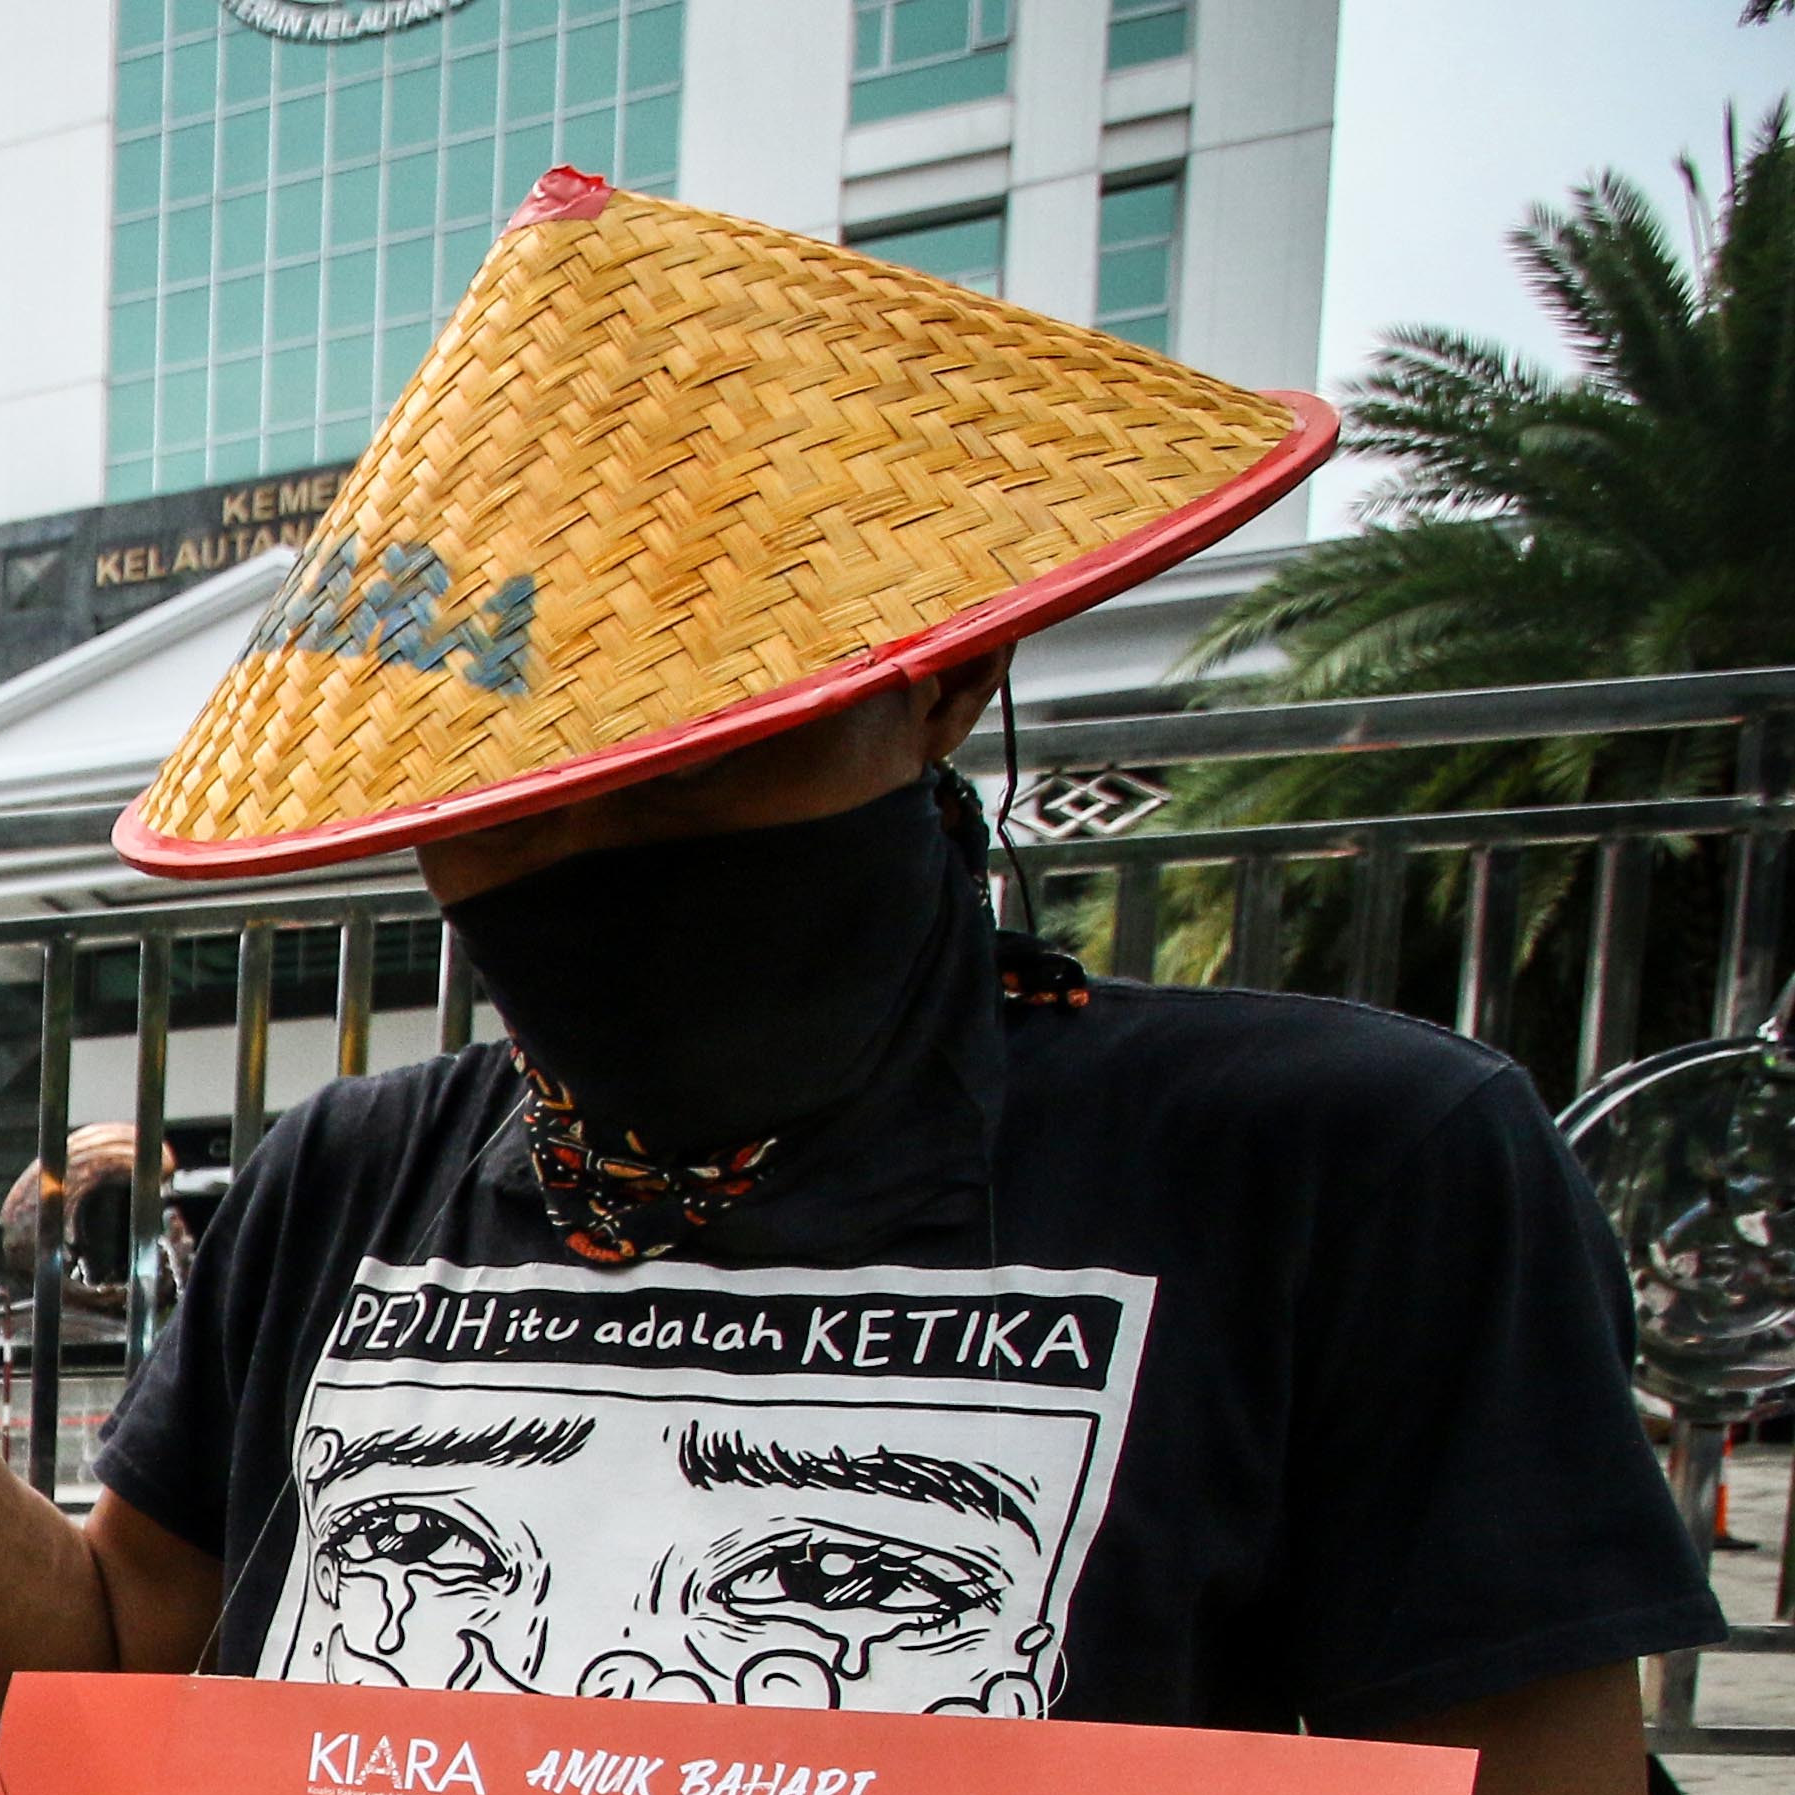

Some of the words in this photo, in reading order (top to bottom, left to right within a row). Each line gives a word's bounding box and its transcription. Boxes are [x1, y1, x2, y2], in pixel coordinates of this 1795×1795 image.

[222, 471, 348, 526] KEME
[505, 1309, 579, 1345] itu
[593, 1309, 786, 1353] adalah
[800, 1307, 1091, 1371] KETIKA
[308, 1731, 487, 1795] KIARA
